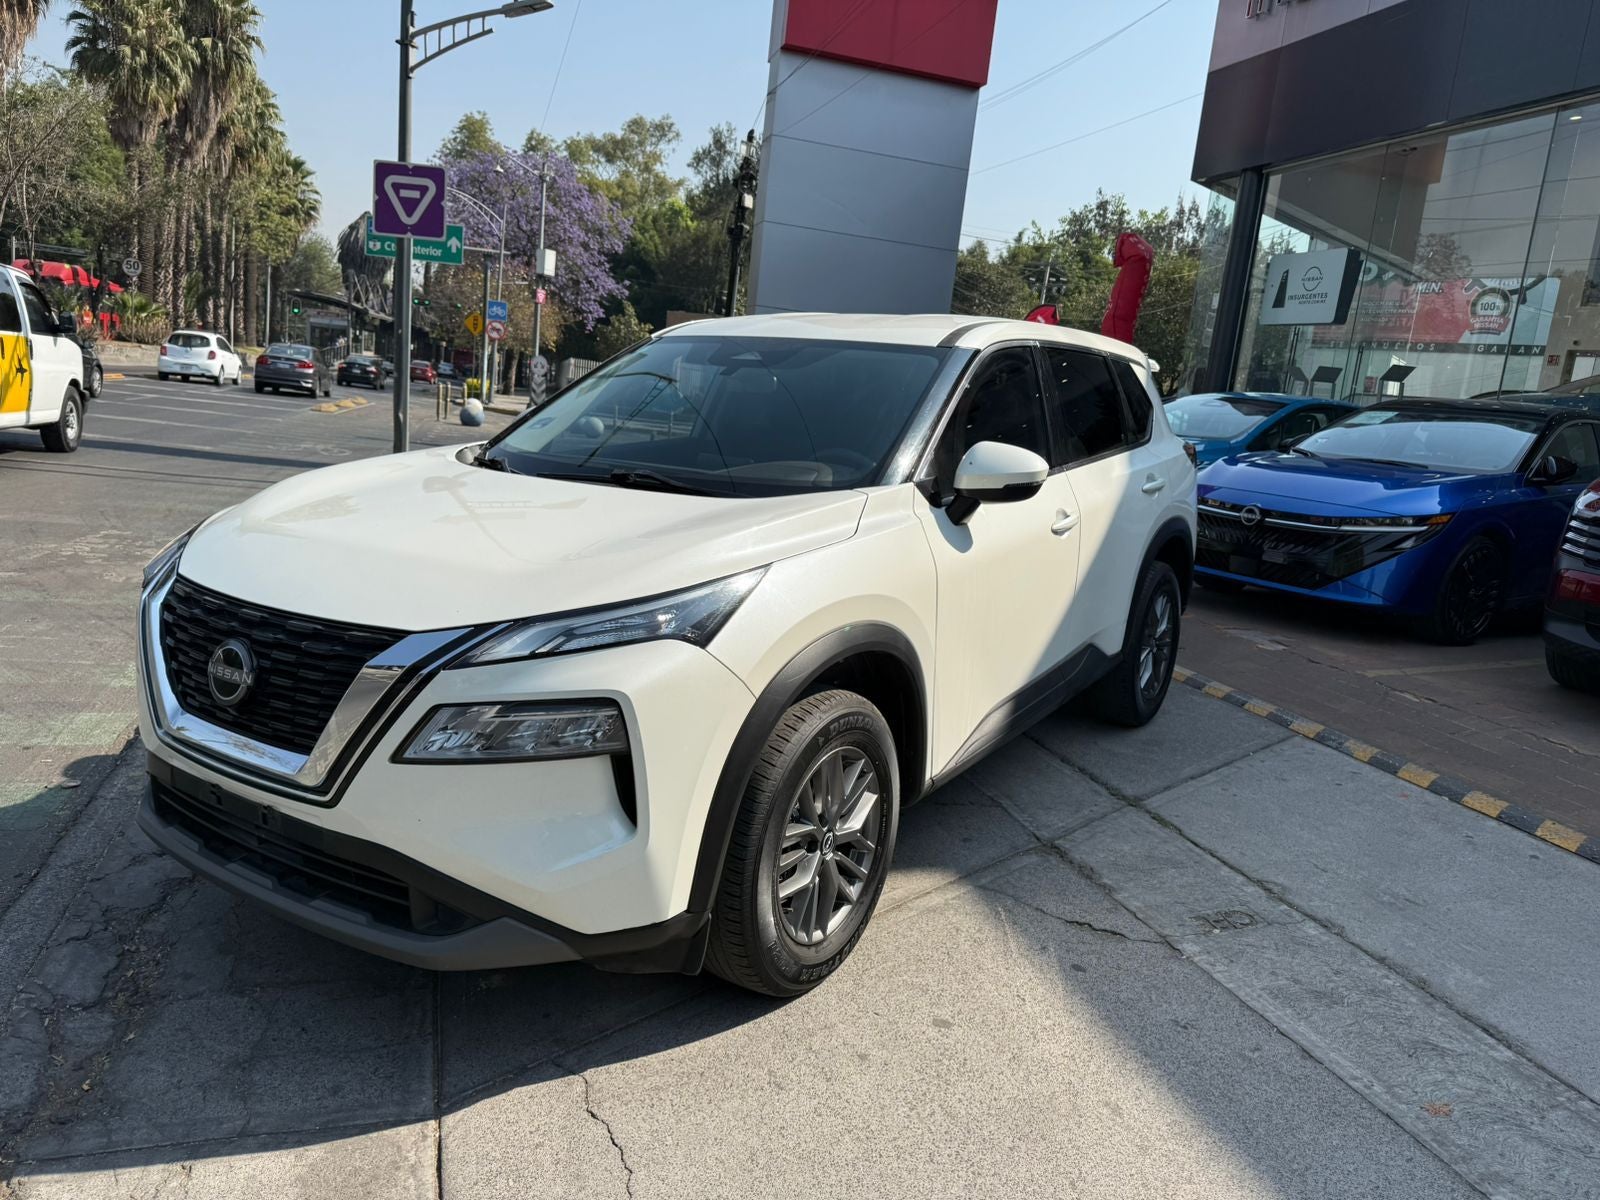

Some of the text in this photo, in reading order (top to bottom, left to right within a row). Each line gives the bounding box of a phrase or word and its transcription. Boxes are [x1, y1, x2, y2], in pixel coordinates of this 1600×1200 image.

[384, 241, 442, 256] Ct nterior
[125, 260, 139, 270] 50
[208, 661, 252, 683] NISSAN
